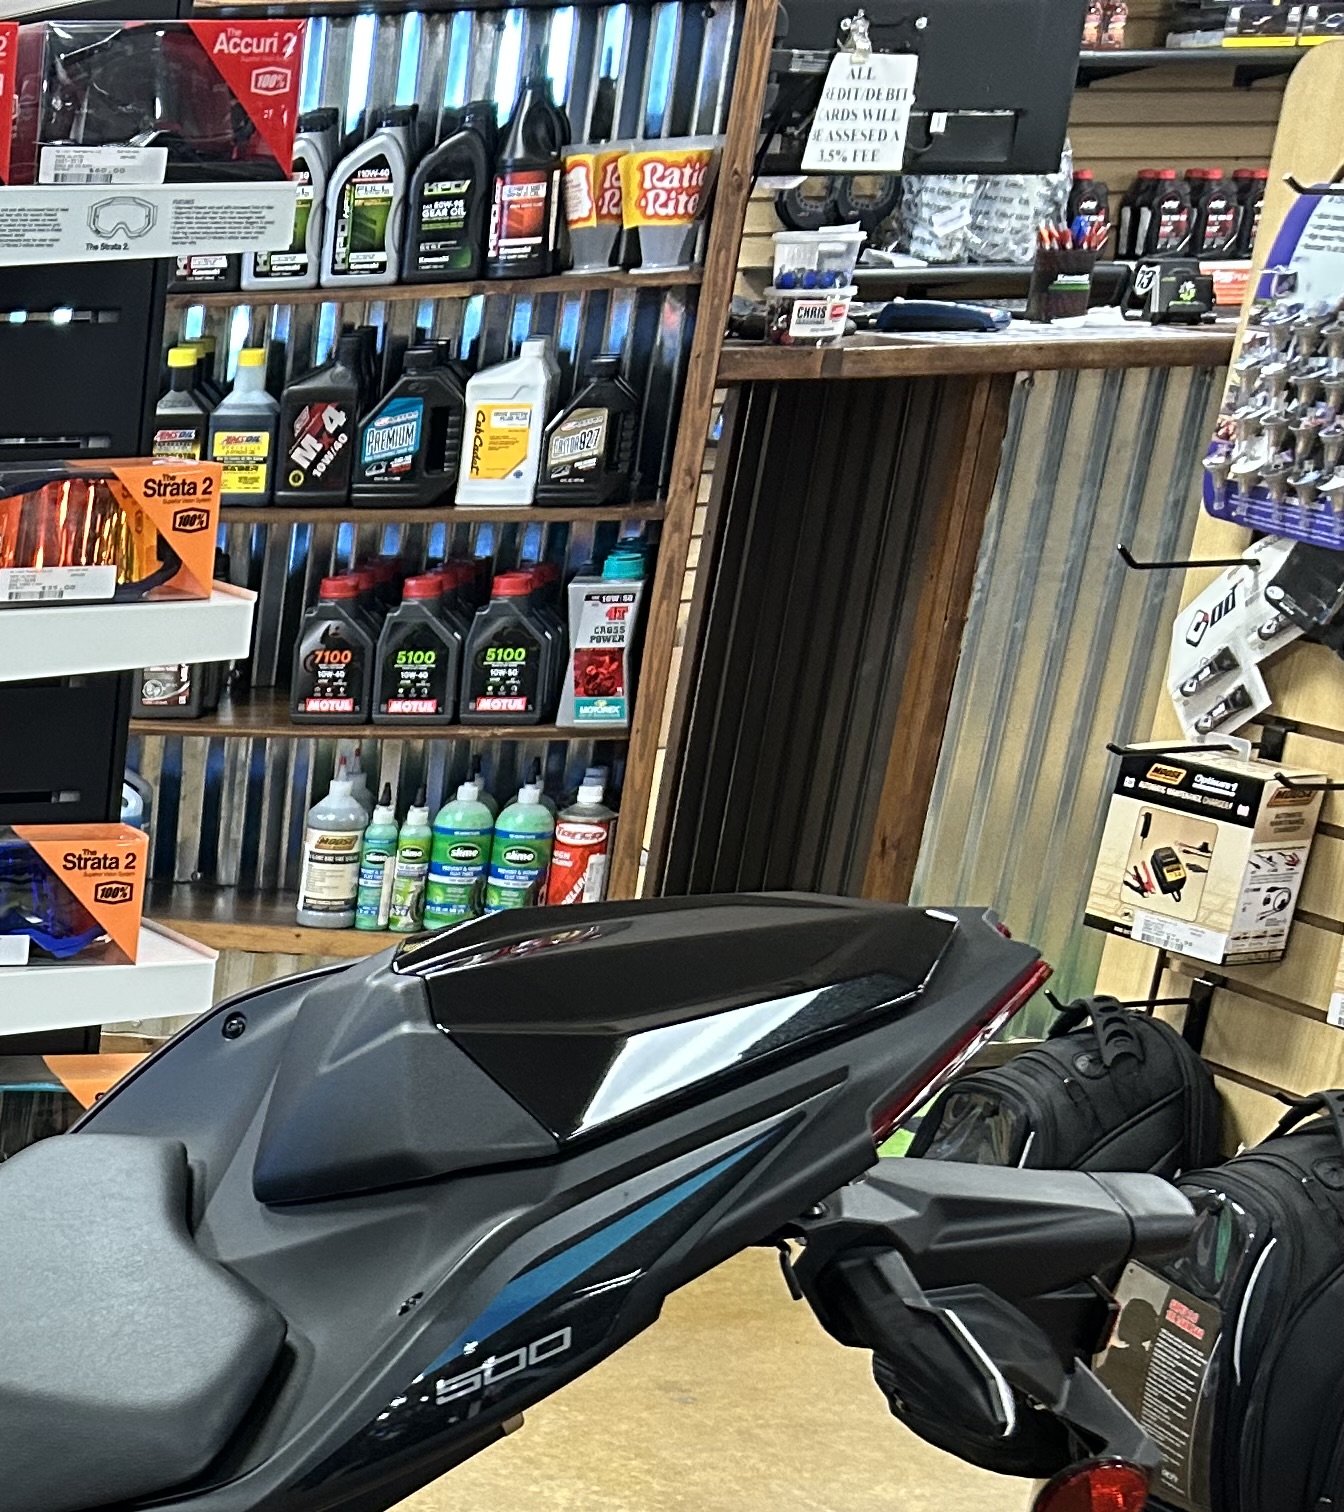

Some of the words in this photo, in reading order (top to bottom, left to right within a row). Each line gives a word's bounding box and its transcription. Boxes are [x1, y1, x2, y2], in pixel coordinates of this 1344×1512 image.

[226, 28, 242, 37] The
[213, 32, 279, 54] Accuri
[283, 32, 297, 57] 2
[846, 66, 876, 81] ALL
[256, 73, 286, 88] 100%
[863, 108, 901, 121] WILL
[828, 128, 888, 141] ASSESED
[891, 129, 900, 141] A
[852, 148, 881, 163] FEE
[797, 306, 828, 319] CHRIS
[474, 409, 486, 434] Cub
[365, 422, 417, 457] PREMIUM
[470, 434, 484, 476] Cadet
[162, 473, 176, 481] The
[143, 478, 197, 498] Strata
[202, 476, 213, 495] 2
[178, 513, 205, 528] 100%
[605, 606, 629, 621] 4T
[589, 634, 625, 644] POWER
[314, 650, 352, 664] 7100
[396, 651, 436, 664] 5100
[485, 648, 526, 661] 5100
[306, 699, 353, 711] MOTUL
[388, 700, 436, 712] MOTUL
[477, 697, 526, 710] MOTUL
[82, 848, 97, 856] The
[450, 846, 479, 858] slime
[504, 850, 534, 861] slime
[62, 853, 120, 870] Strata
[124, 852, 136, 870] 2
[99, 887, 128, 899] 100%
[436, 1326, 572, 1406] 500
